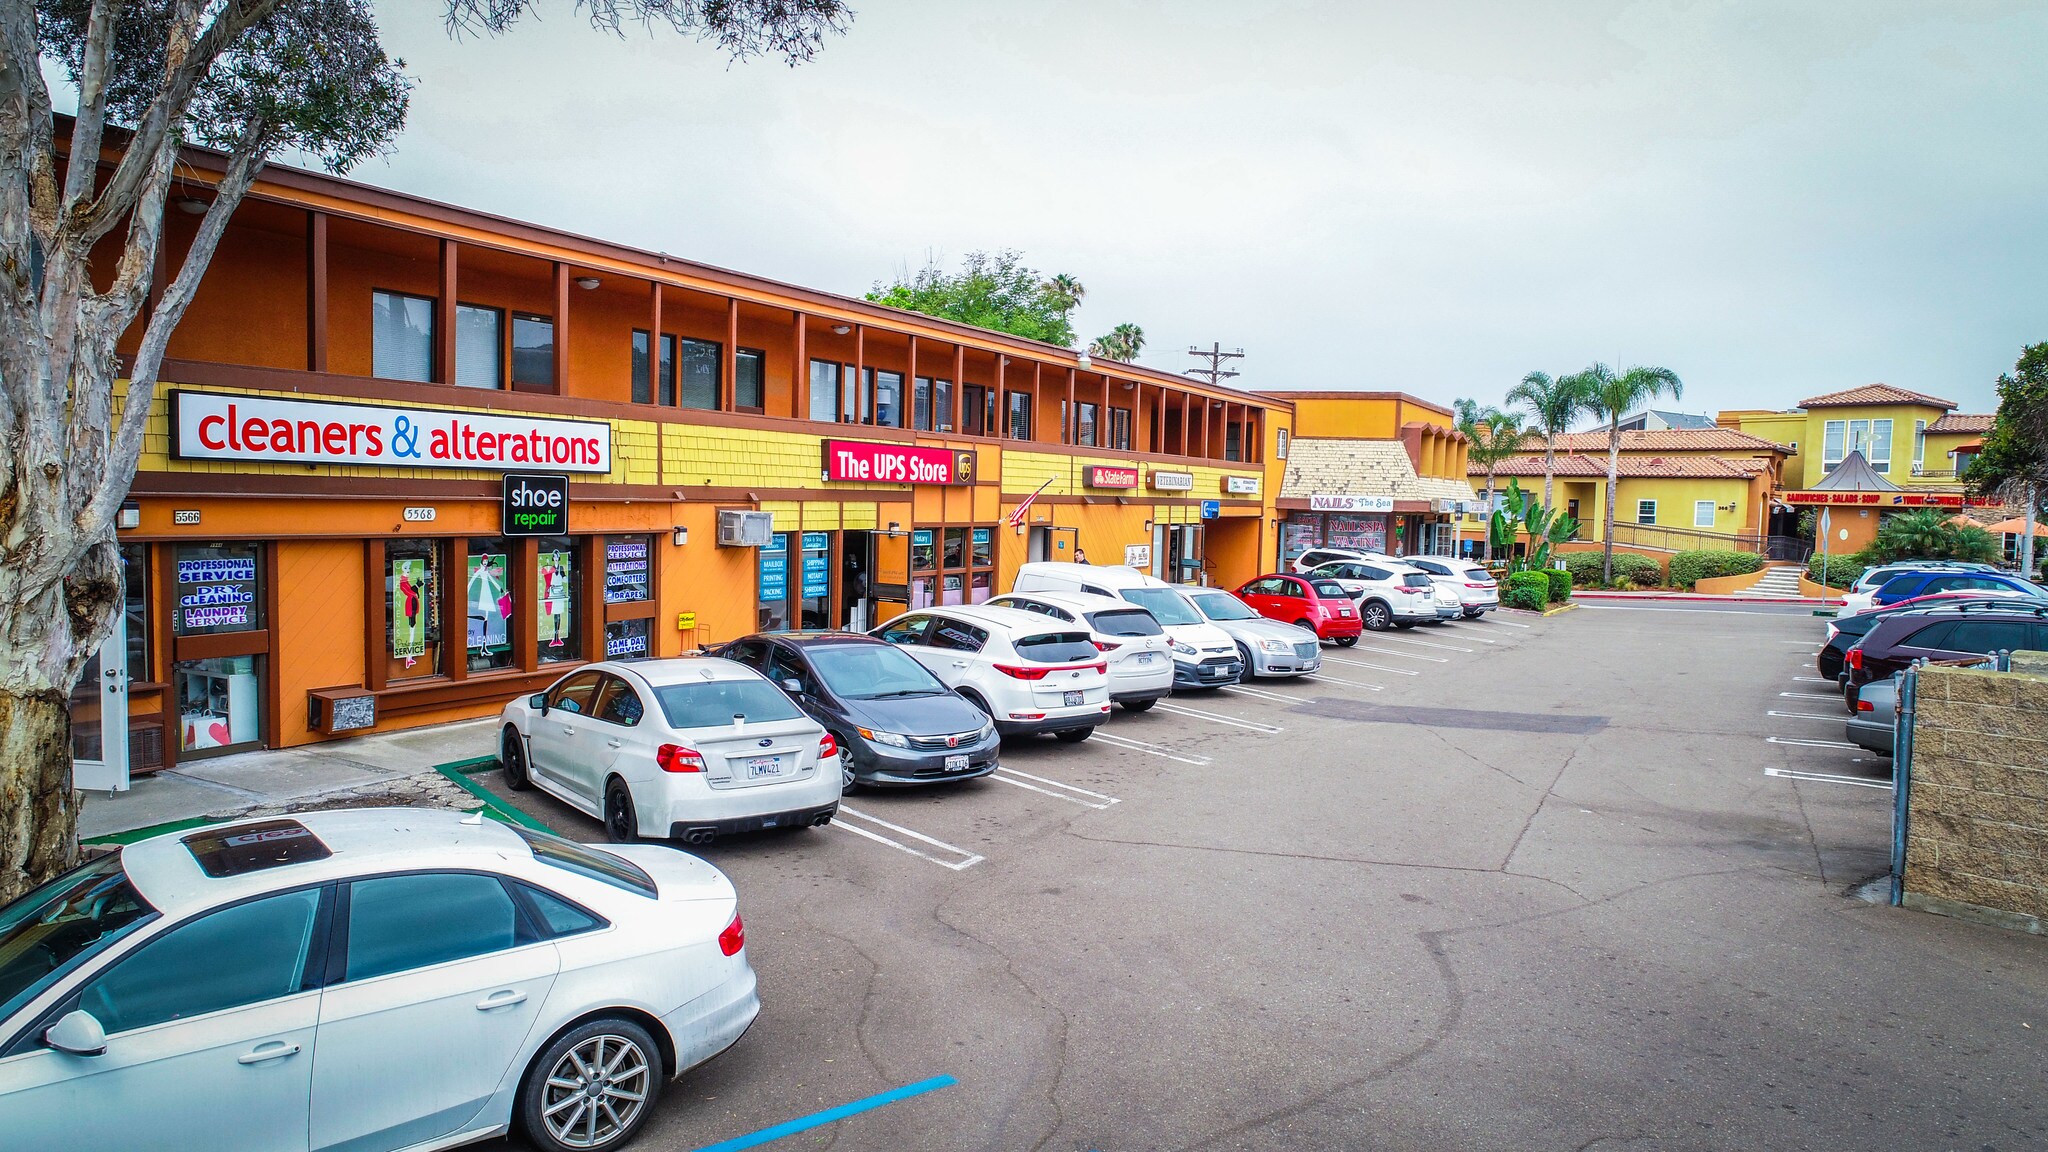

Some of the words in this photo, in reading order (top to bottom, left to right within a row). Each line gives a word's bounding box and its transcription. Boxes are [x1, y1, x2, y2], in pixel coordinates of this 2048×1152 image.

[198, 403, 384, 457] cleaners
[391, 415, 422, 459] &
[429, 419, 600, 465] alterations
[837, 450, 870, 479] The
[873, 453, 906, 480] UPS
[909, 455, 948, 482] Store
[959, 462, 971, 478] ups
[511, 480, 562, 508] shoe
[1786, 493, 1829, 503] SANDWICHES
[1832, 494, 1859, 503] SALADS
[1861, 494, 1880, 504] SOUP
[1312, 497, 1354, 509] NAILS
[1359, 498, 1374, 507] The
[1376, 498, 1391, 508] Sea
[176, 512, 200, 523] 5566
[407, 509, 434, 520] 5568
[514, 509, 557, 530] repair
[1333, 535, 1381, 548] WAXING
[607, 544, 647, 552] PROFESSIONAL
[608, 551, 646, 559] SERVICE
[178, 559, 254, 572] PROFESSIONAL
[608, 561, 647, 572] ALTERATIONS
[763, 560, 783, 568] MAILBOX
[806, 559, 825, 567] SHIPPING
[179, 570, 254, 582] SERVICE
[607, 573, 646, 586] COMFORTERS
[763, 574, 783, 582] PRINTING
[807, 572, 824, 580] NOTARY
[197, 585, 242, 595] DRY
[614, 590, 643, 600] DRAPES
[763, 588, 783, 596] PACKING
[804, 586, 826, 594] SHREDDING
[181, 593, 252, 605] CLEANING
[185, 605, 247, 619] LAUNDRY
[186, 616, 247, 627] SERVICE
[467, 634, 506, 646] CLEANING
[608, 638, 629, 650] SAME
[630, 636, 646, 646] DAY
[394, 645, 424, 656] SERVICE
[608, 644, 646, 656] SERVICE
[750, 764, 780, 776] 7LMV421
